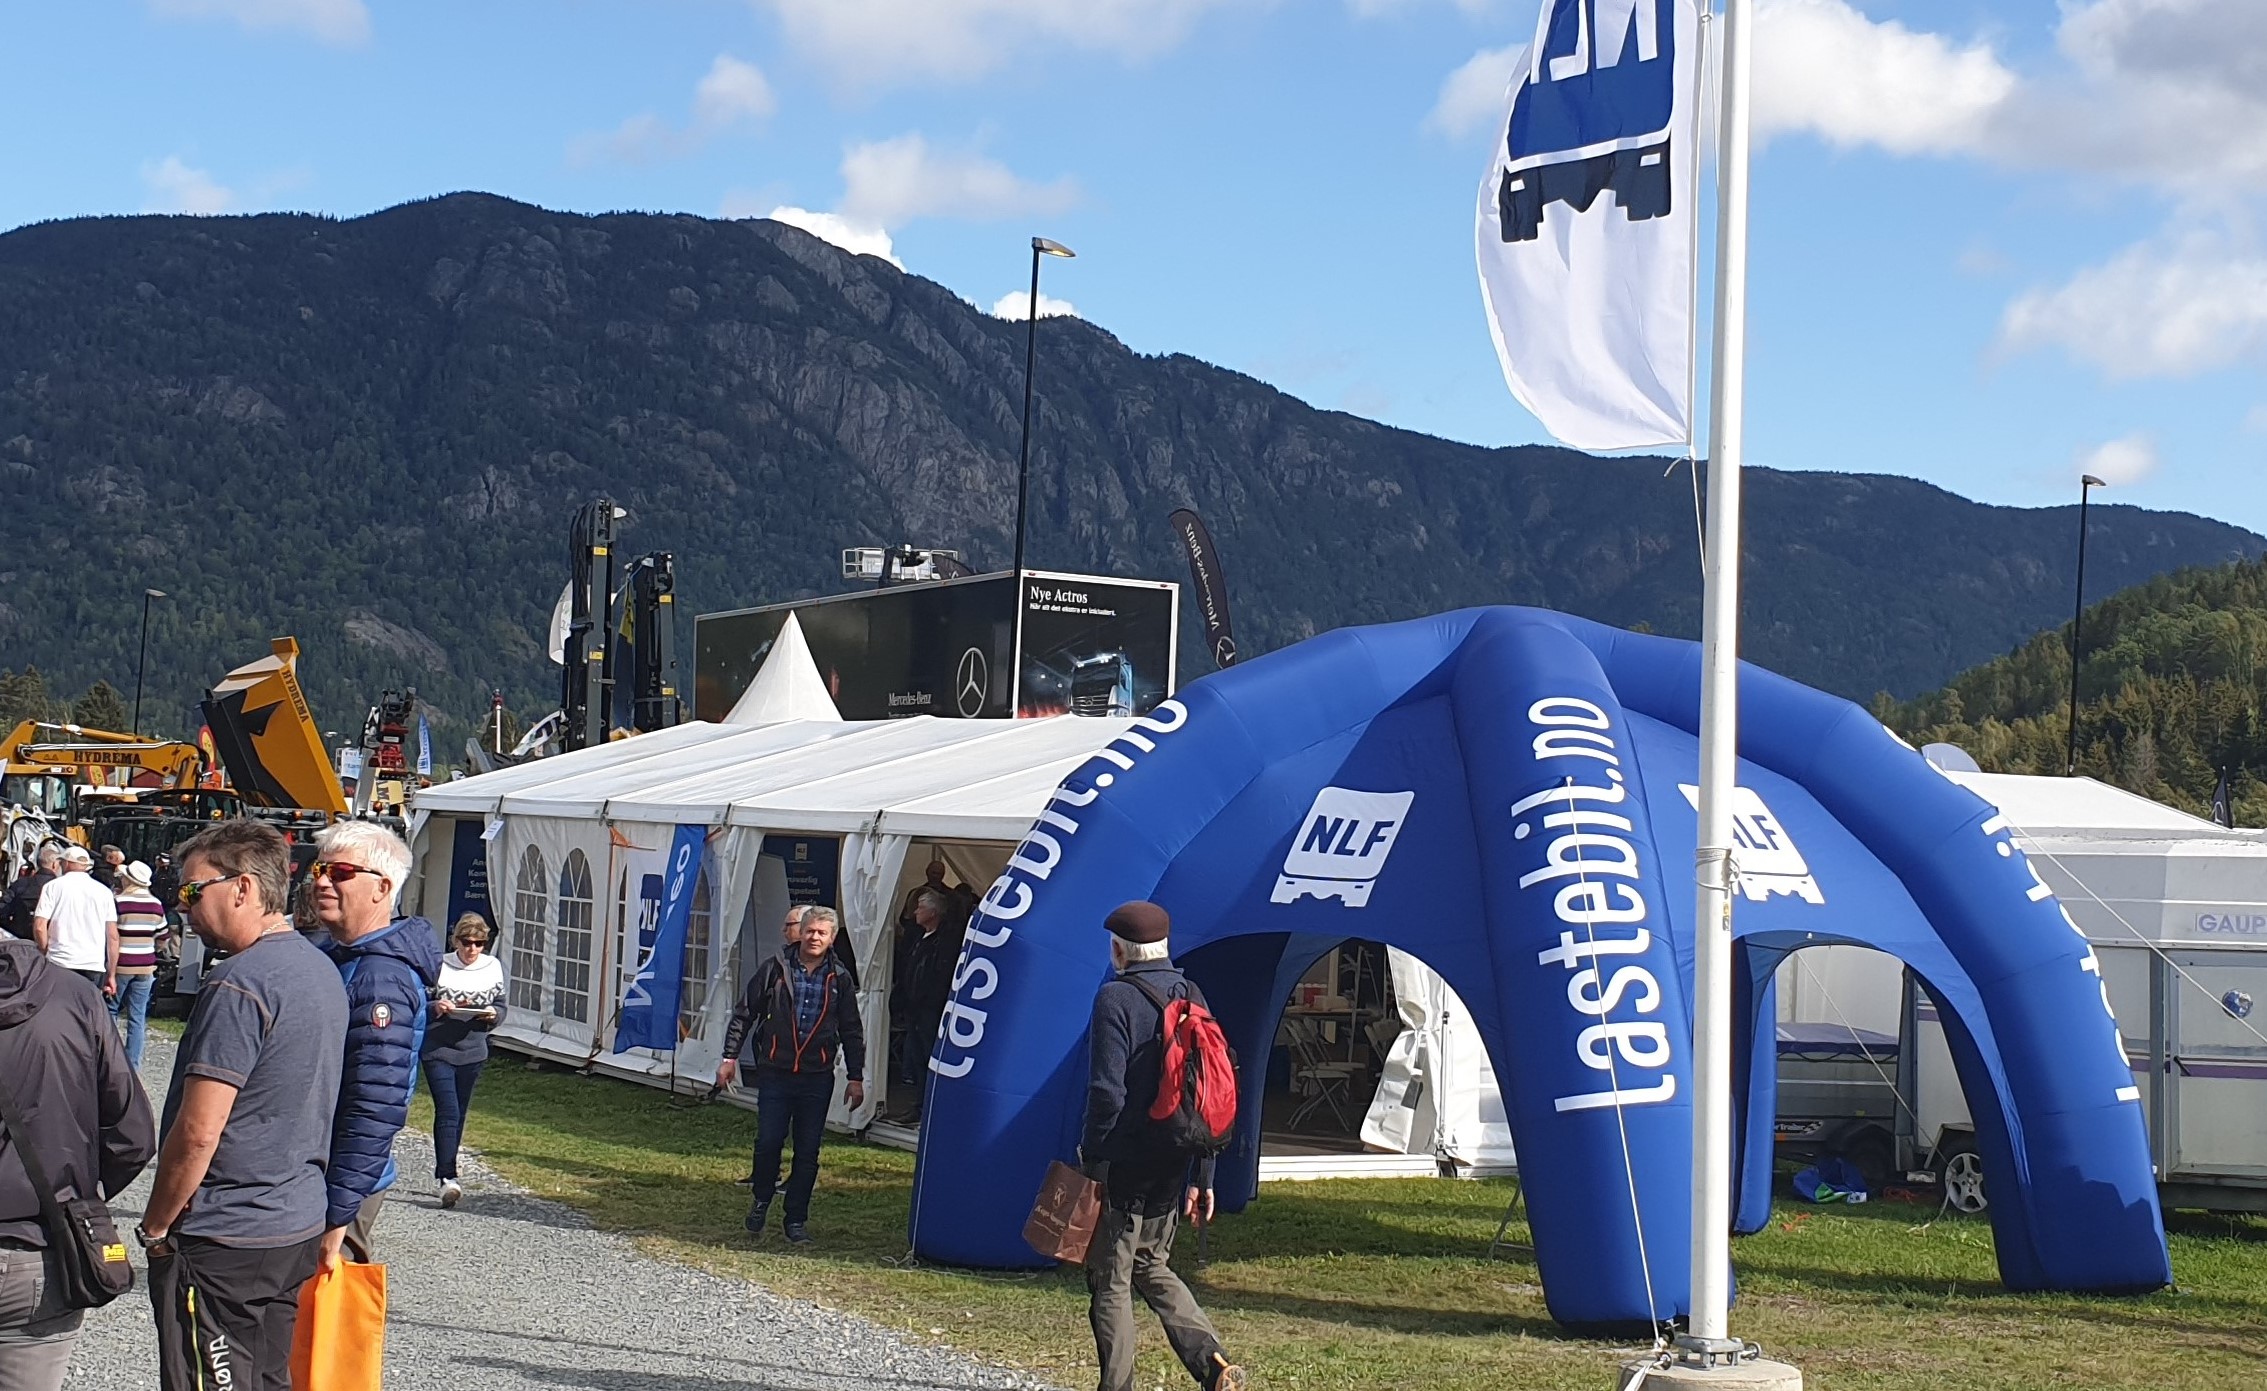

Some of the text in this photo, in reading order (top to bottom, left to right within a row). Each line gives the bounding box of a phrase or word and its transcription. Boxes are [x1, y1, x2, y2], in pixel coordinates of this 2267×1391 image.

[1030, 586, 1088, 604] Nye Actros
[282, 669, 310, 723] HYDREMA
[74, 750, 142, 764] HYDREMA
[1301, 814, 1395, 858] NLF
[640, 897, 661, 932] NLF
[1511, 697, 1677, 1113] lastebil.no
